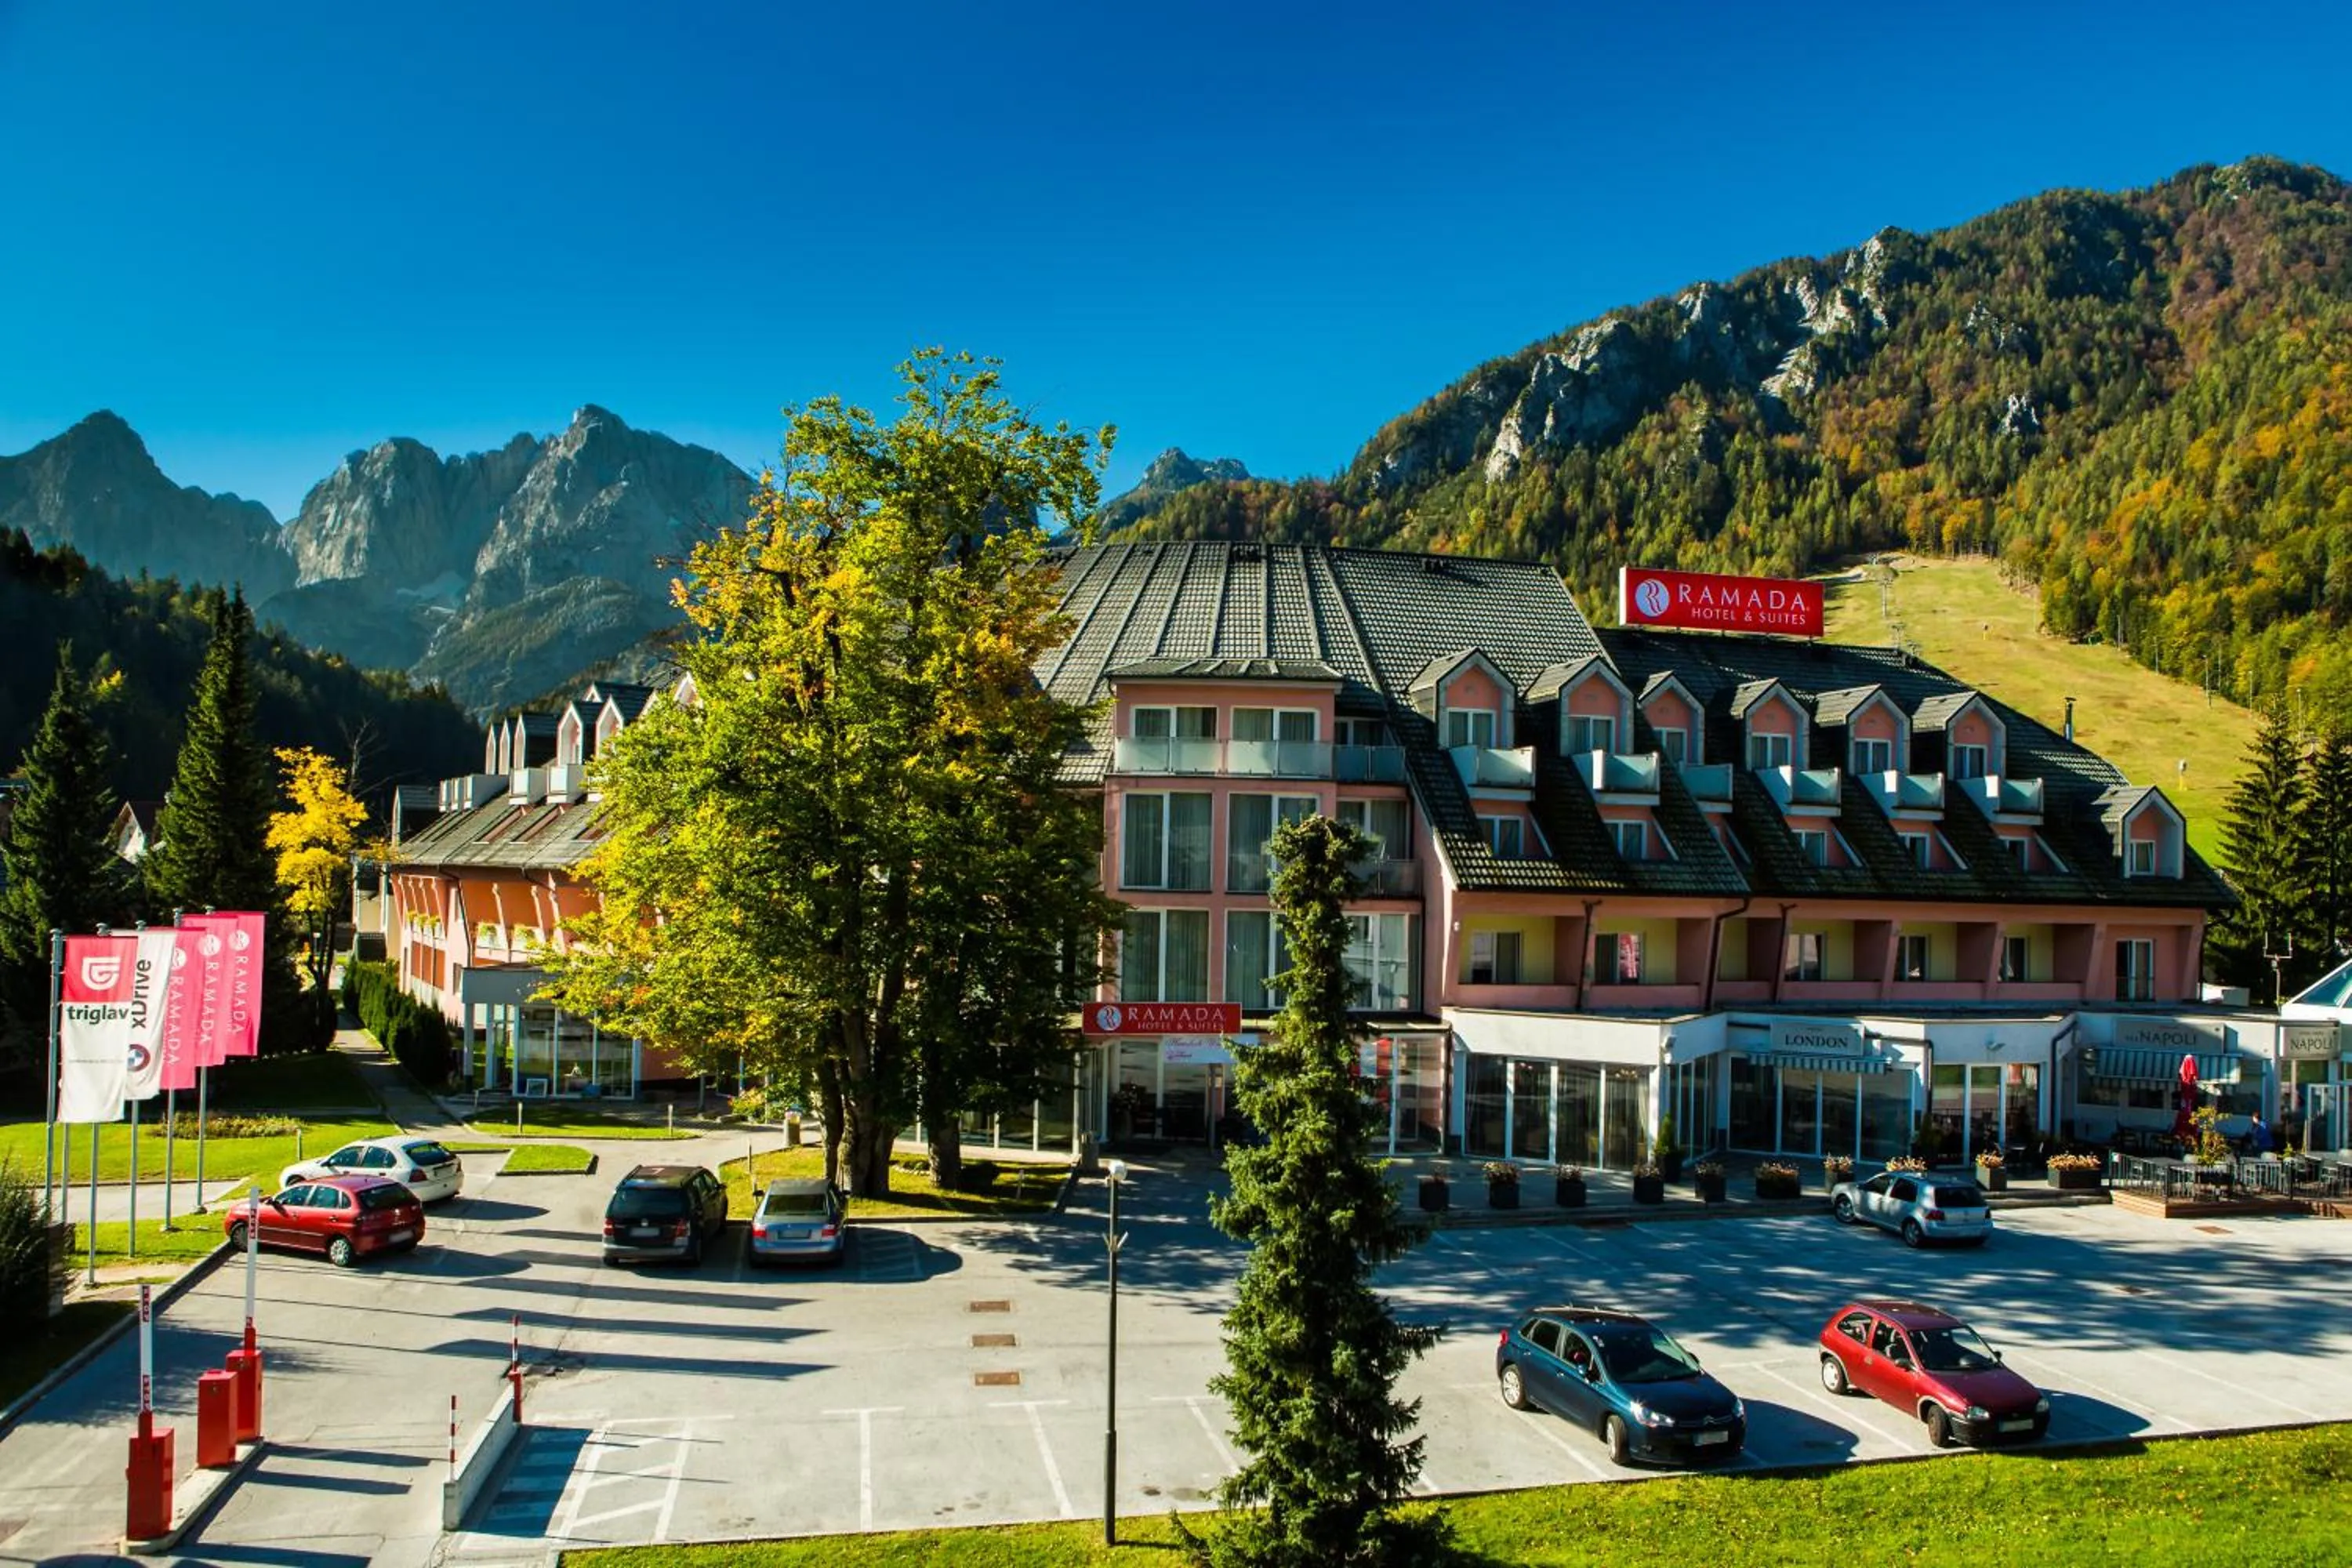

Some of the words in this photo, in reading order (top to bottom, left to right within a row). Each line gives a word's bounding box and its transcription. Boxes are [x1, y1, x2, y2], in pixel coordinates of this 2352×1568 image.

[1678, 584, 1808, 612] RAMADA
[1691, 607, 1736, 622] HOTEL
[1744, 612, 1752, 622] &
[1759, 612, 1806, 626] SUITES
[132, 959, 151, 1029] xDrive
[201, 960, 220, 1044] RAMADA
[234, 956, 250, 1033] RAMADA
[67, 1004, 129, 1025] triglav
[166, 975, 187, 1065] RAMADA
[1127, 1007, 1225, 1021] RAMADA
[1138, 1020, 1173, 1030] HOTEL
[1188, 1021, 1225, 1031] SUITES
[1785, 1034, 1848, 1048] LONDON
[2140, 1029, 2198, 1047] NAPOLI
[2289, 1036, 2334, 1052] NAPOLI
